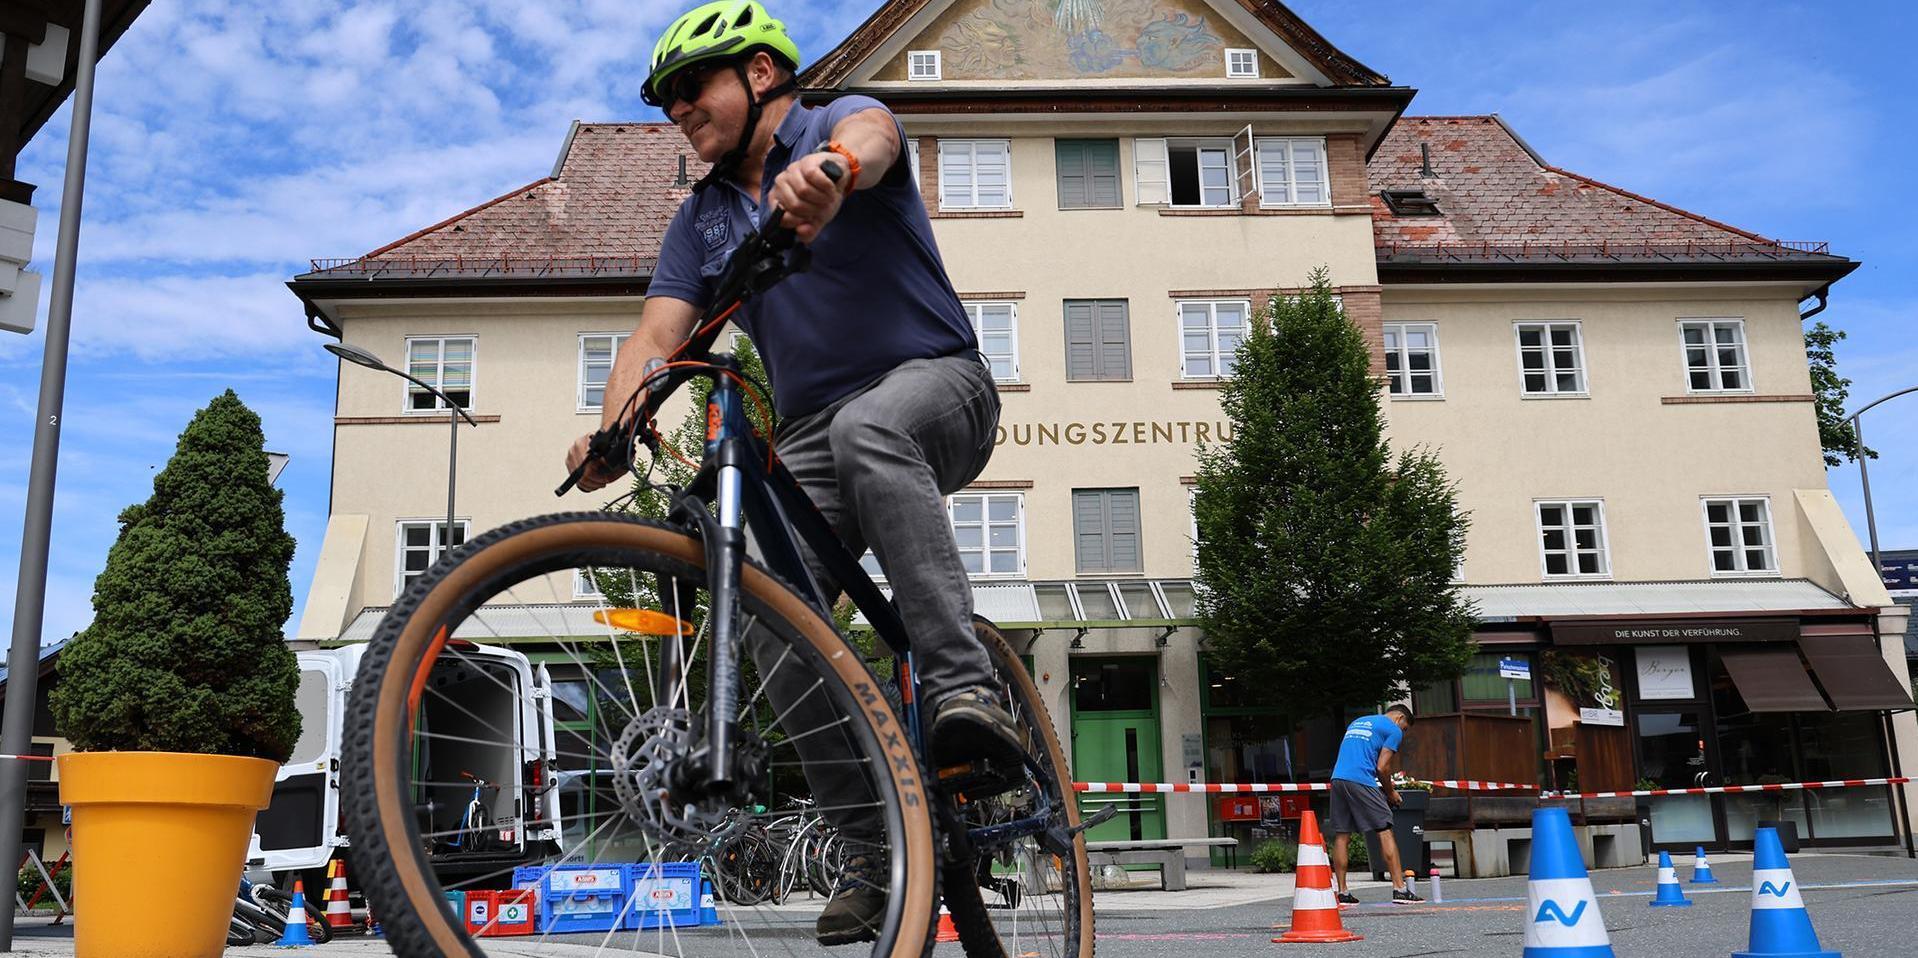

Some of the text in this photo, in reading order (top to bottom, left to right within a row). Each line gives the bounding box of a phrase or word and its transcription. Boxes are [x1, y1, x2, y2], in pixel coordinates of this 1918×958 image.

[49, 415, 57, 426] 2
[1615, 627, 1743, 638] DIE KUNST DER VERFÜHRUNG.
[854, 682, 919, 807] MAXXIS
